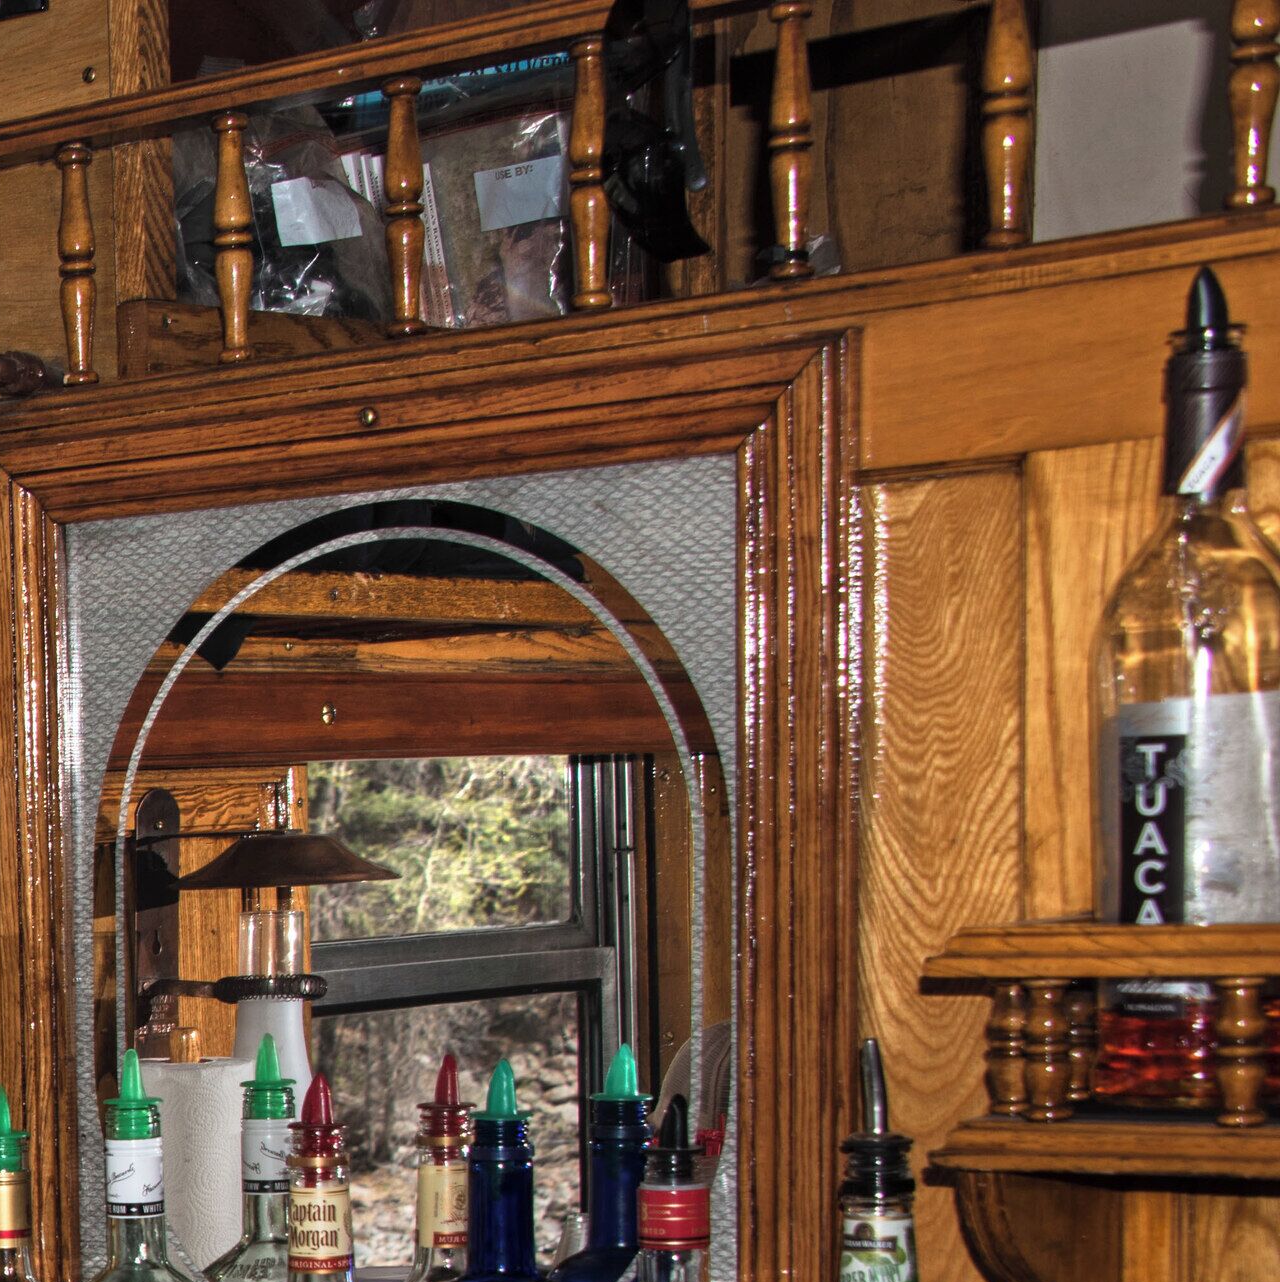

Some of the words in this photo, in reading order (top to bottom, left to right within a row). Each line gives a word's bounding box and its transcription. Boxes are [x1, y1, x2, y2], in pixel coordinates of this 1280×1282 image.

[495, 169, 513, 182] USE
[515, 163, 534, 177] BY:
[1133, 743, 1169, 925] TUACA
[112, 1204, 127, 1214] RUM
[290, 1226, 339, 1250] Morgan
